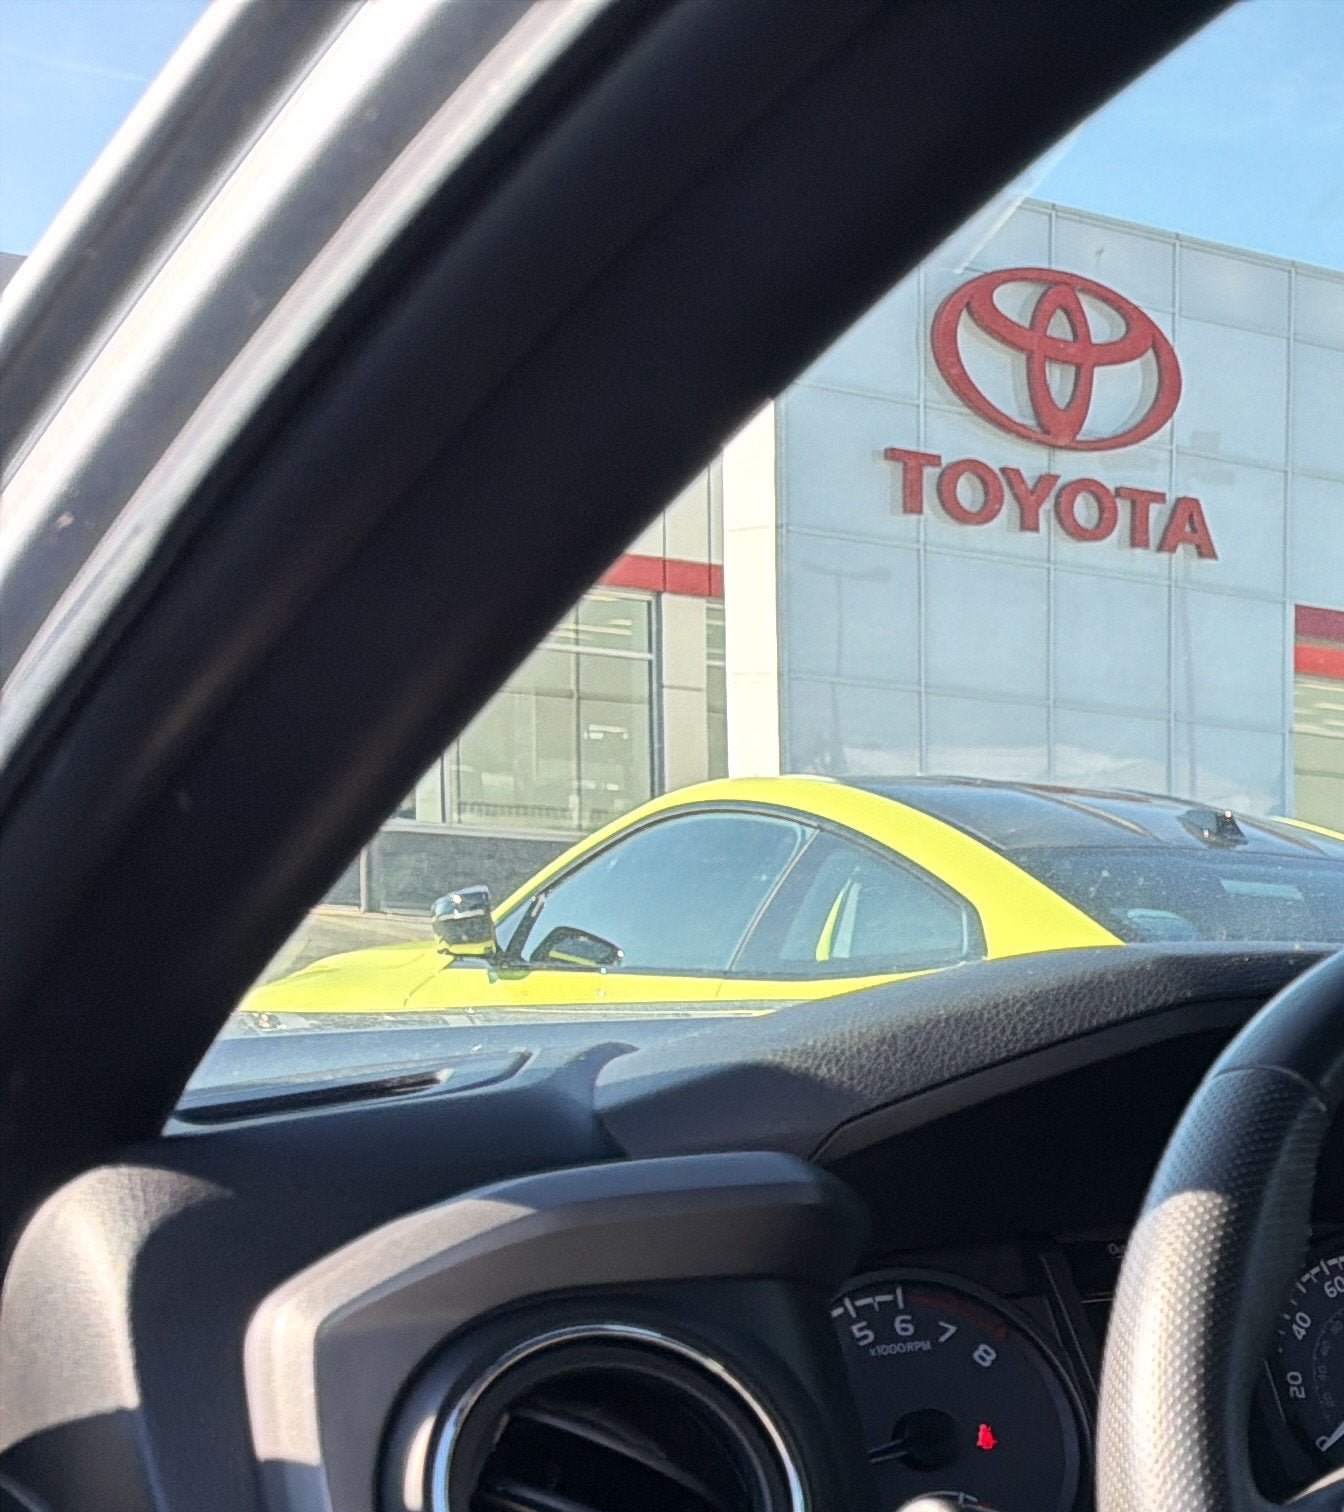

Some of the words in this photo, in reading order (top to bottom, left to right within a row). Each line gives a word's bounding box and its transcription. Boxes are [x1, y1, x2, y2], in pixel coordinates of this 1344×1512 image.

[884, 447, 1218, 560] TOYOTA
[850, 1321, 875, 1347] 5
[893, 1314, 915, 1336] 6
[937, 1320, 958, 1344] 7
[972, 1343, 997, 1368] 8
[1291, 1312, 1312, 1340] 40
[1286, 1371, 1306, 1399] 20
